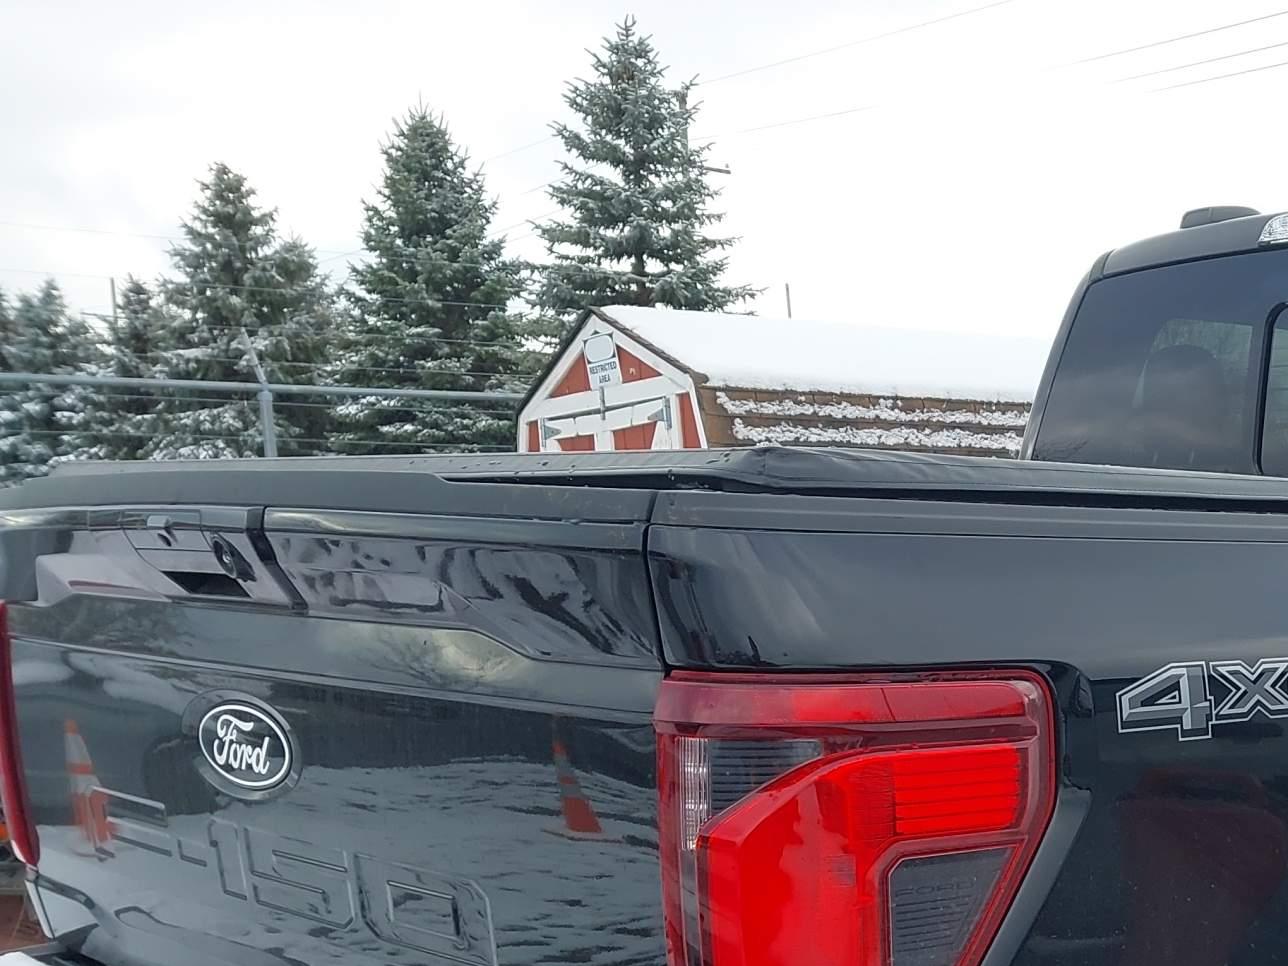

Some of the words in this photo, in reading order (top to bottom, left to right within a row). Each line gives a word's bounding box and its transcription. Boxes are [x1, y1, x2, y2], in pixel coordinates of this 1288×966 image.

[589, 361, 617, 375] RESTRICTED
[599, 374, 611, 384] AREA
[213, 713, 270, 775] Ford
[896, 879, 976, 897] FORD
